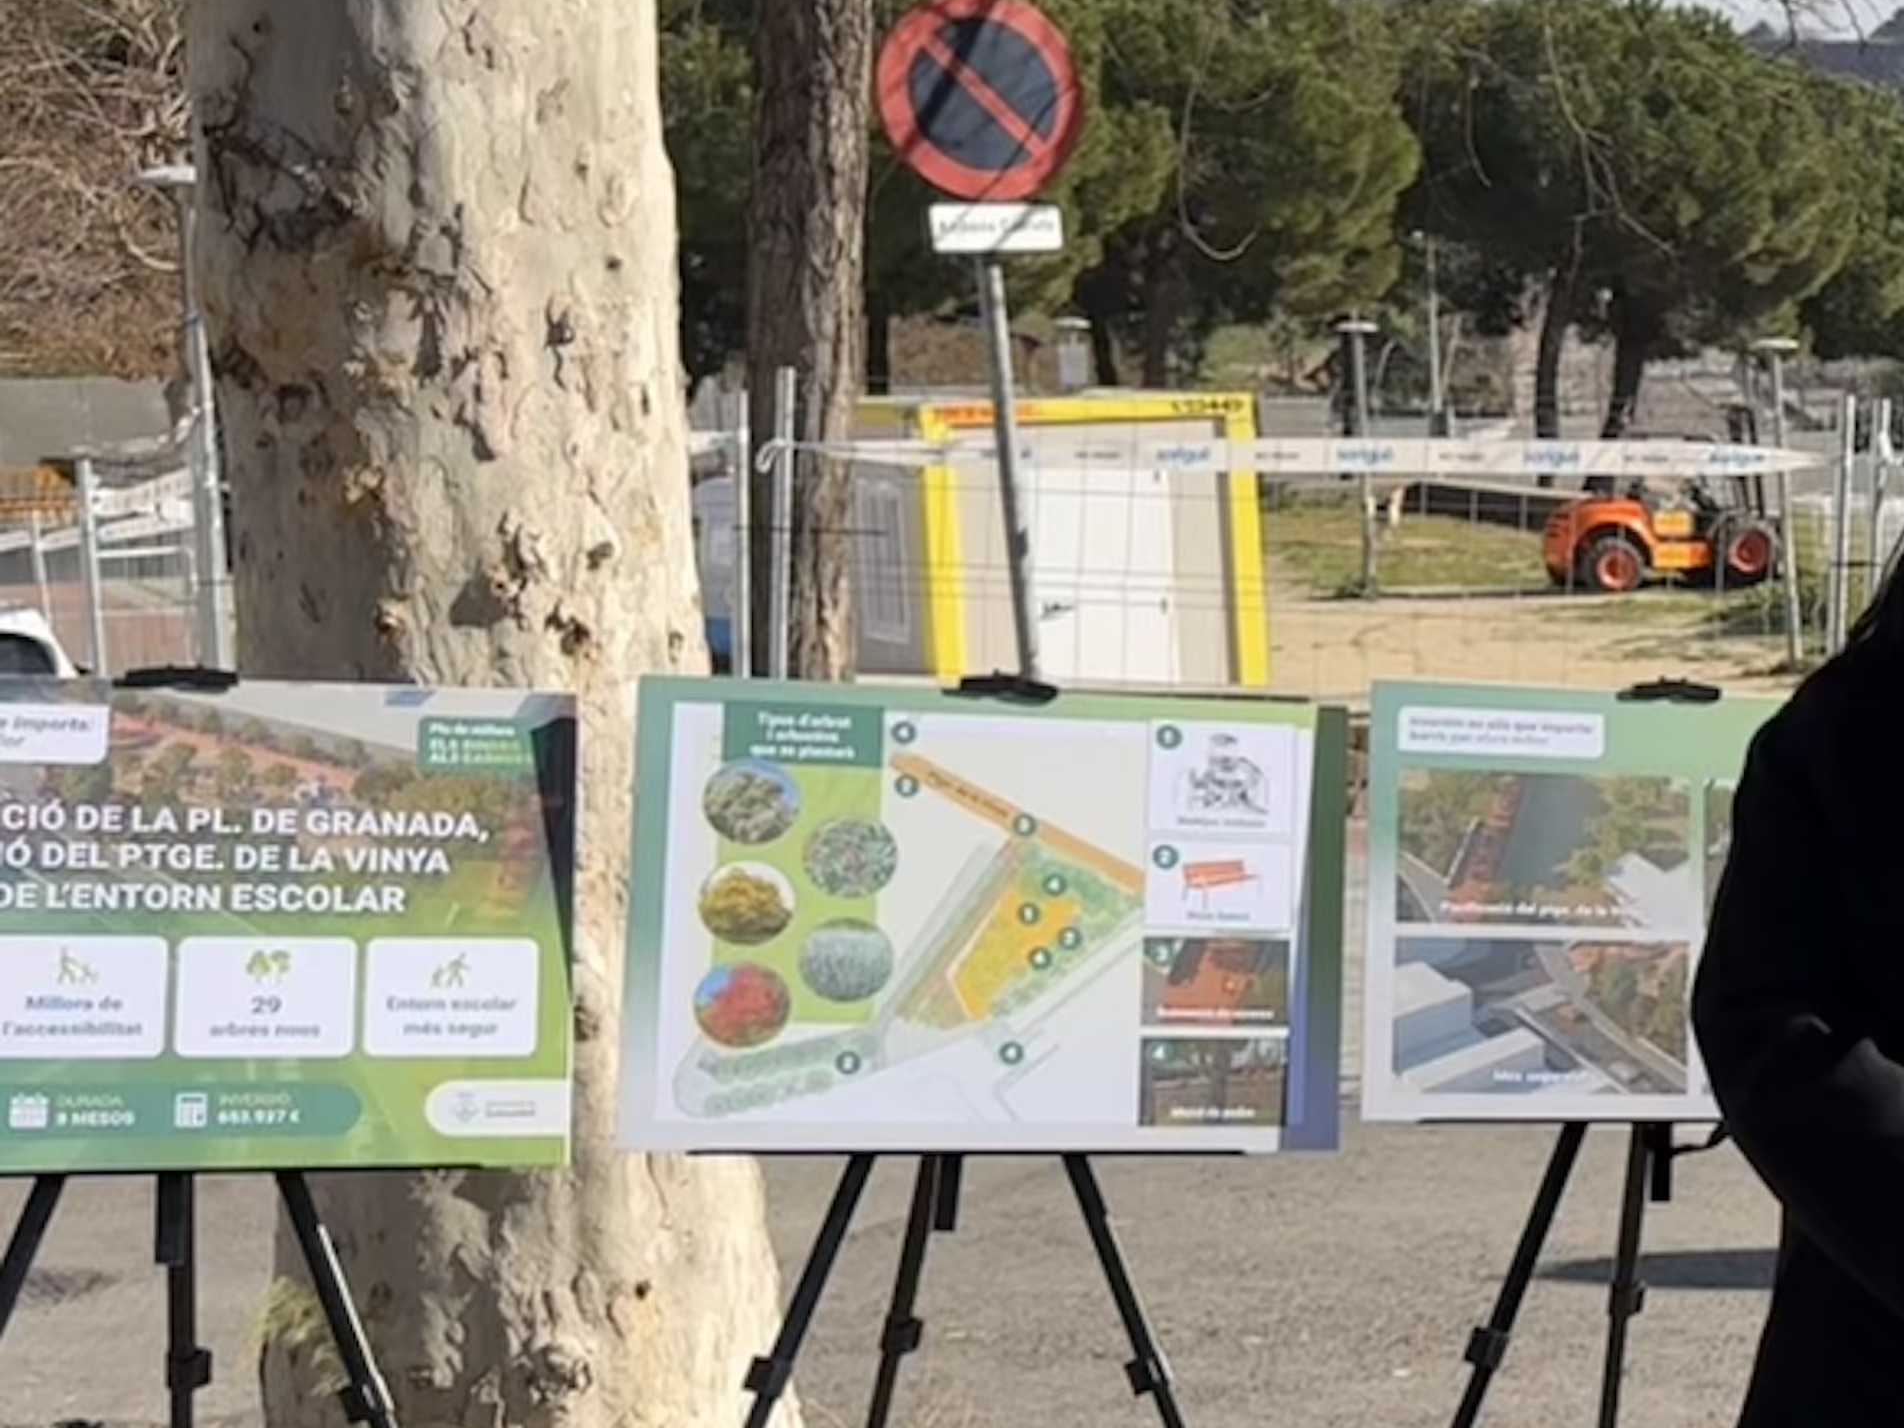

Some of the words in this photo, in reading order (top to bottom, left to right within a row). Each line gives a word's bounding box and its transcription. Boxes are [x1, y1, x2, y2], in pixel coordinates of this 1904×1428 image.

[76, 804, 123, 832] DE
[132, 805, 178, 833] LA
[187, 806, 242, 833] PL.
[253, 808, 297, 834] DE
[306, 810, 489, 844] GRANADA,
[41, 840, 110, 869] DEL
[119, 842, 225, 870] PTGE.
[234, 843, 280, 871] DE
[289, 846, 335, 872] LA
[344, 847, 450, 874] VINYA
[46, 882, 222, 911] L'ENTORN
[231, 883, 406, 913] ESCOLAR
[25, 995, 93, 1011] Millora
[98, 995, 123, 1011] de
[250, 996, 282, 1014] 29
[386, 995, 447, 1012] Entorn
[452, 995, 518, 1012] escolar
[209, 1021, 269, 1038] arbres
